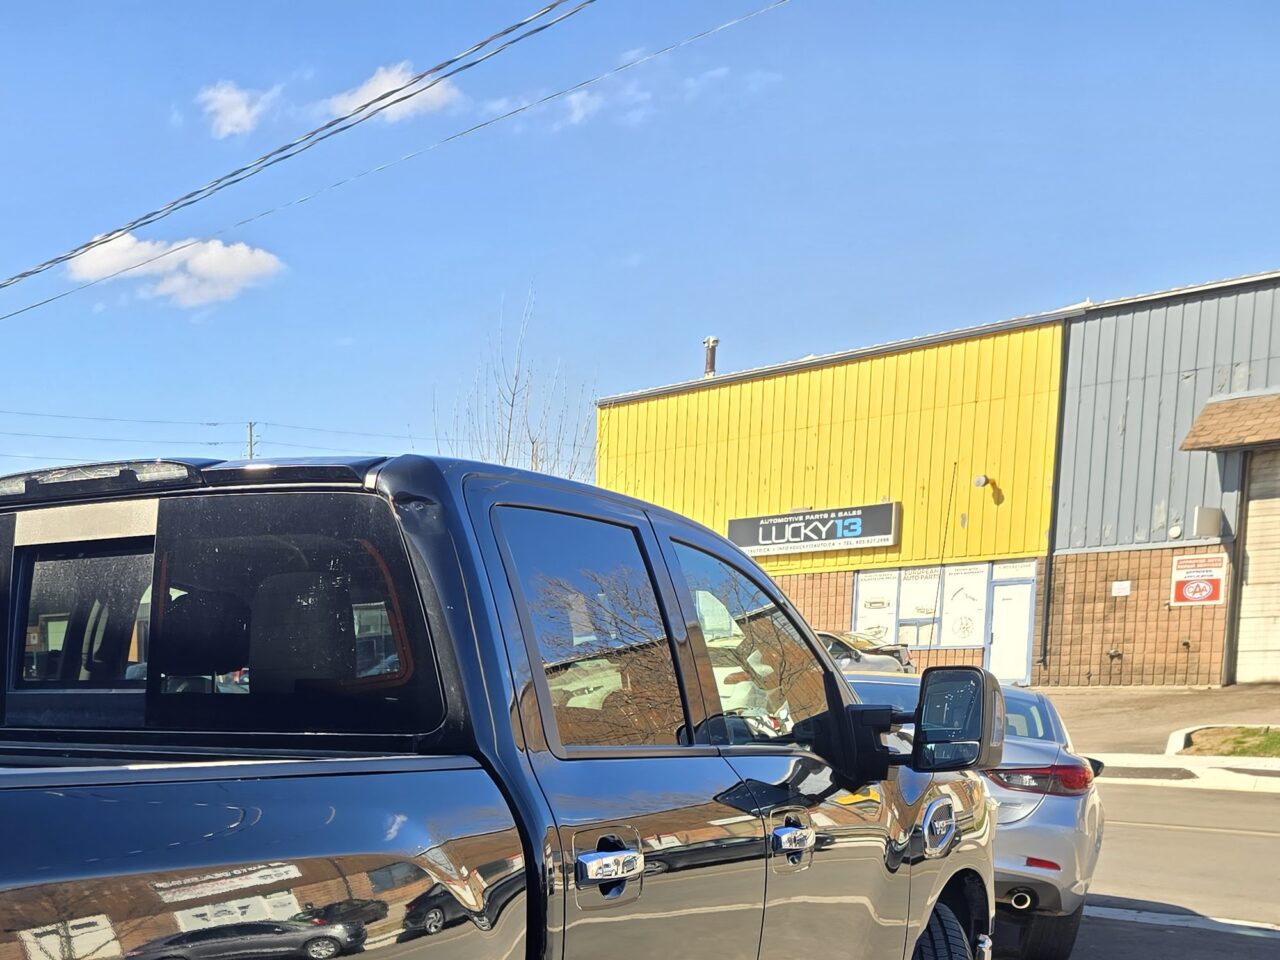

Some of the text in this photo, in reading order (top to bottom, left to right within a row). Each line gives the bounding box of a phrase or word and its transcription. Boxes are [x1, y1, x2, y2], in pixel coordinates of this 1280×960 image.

[759, 509, 862, 525] AUTOMOTIVE PARTS & SALES
[1187, 583, 1208, 597] CAA
